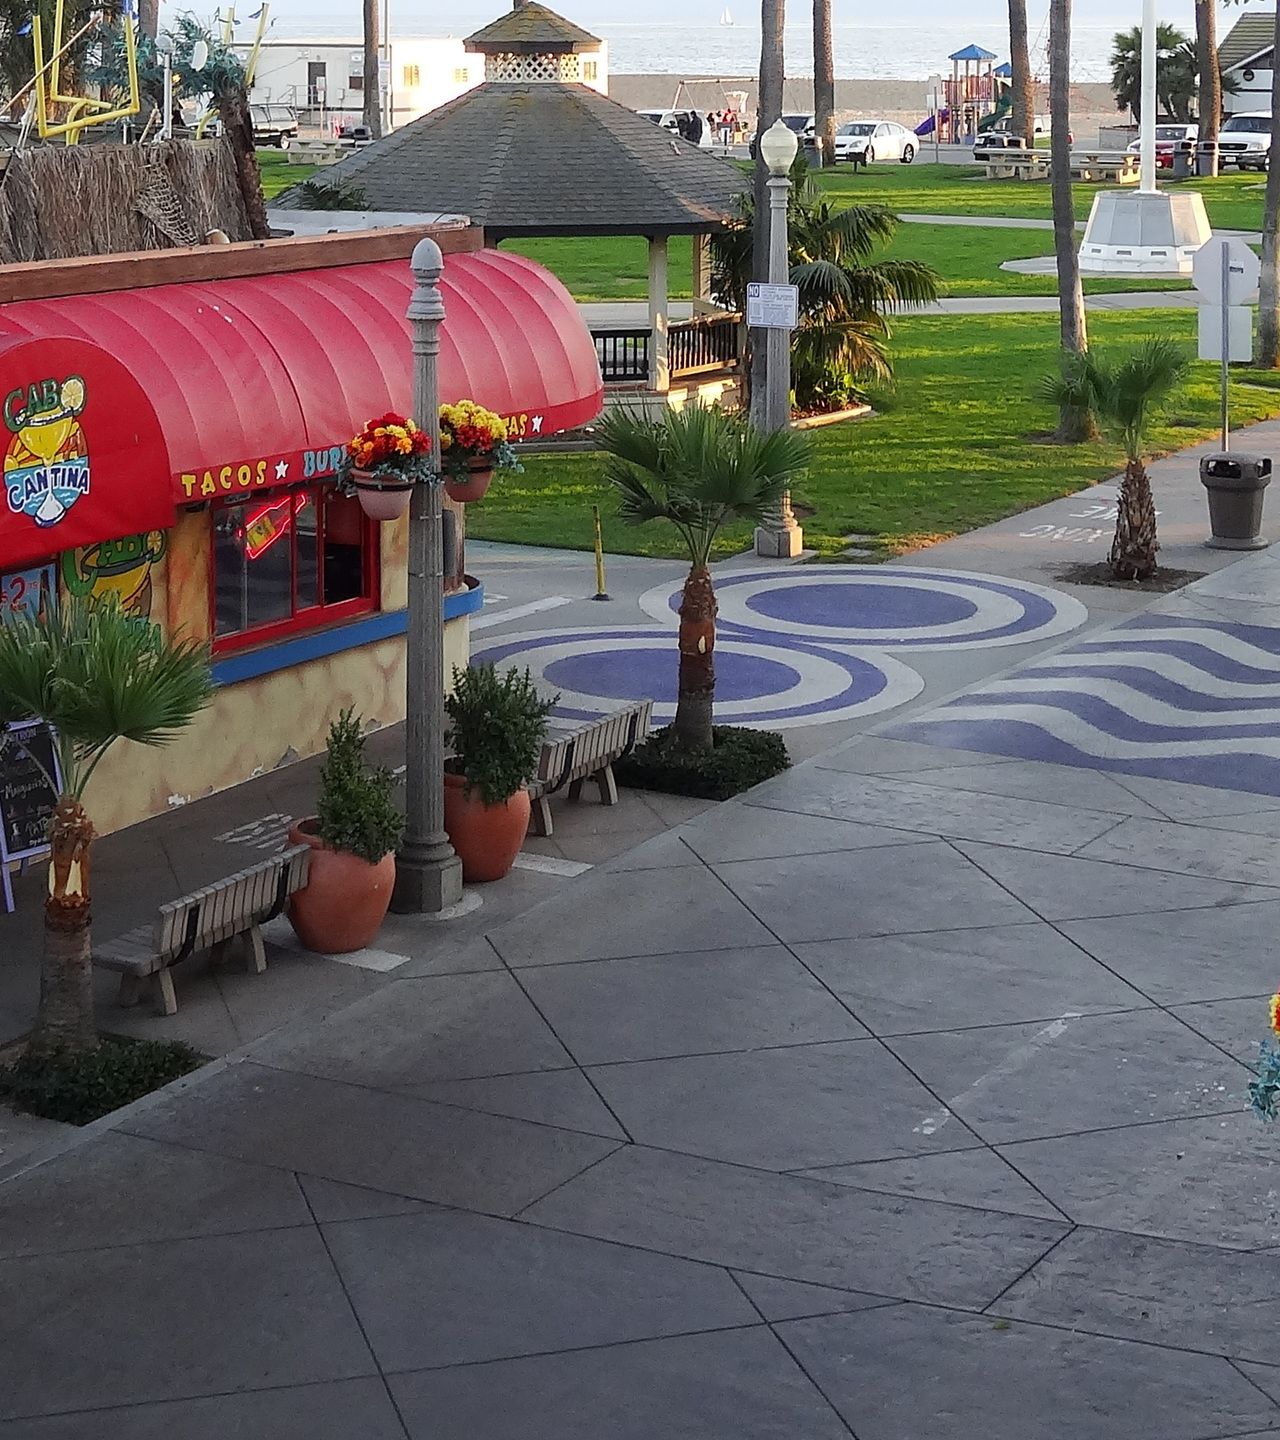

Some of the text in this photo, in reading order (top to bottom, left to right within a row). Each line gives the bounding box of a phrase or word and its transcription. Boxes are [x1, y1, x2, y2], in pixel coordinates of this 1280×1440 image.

[2, 374, 87, 433] CABO
[7, 465, 91, 513] CANTINA
[181, 460, 267, 497] TACOS
